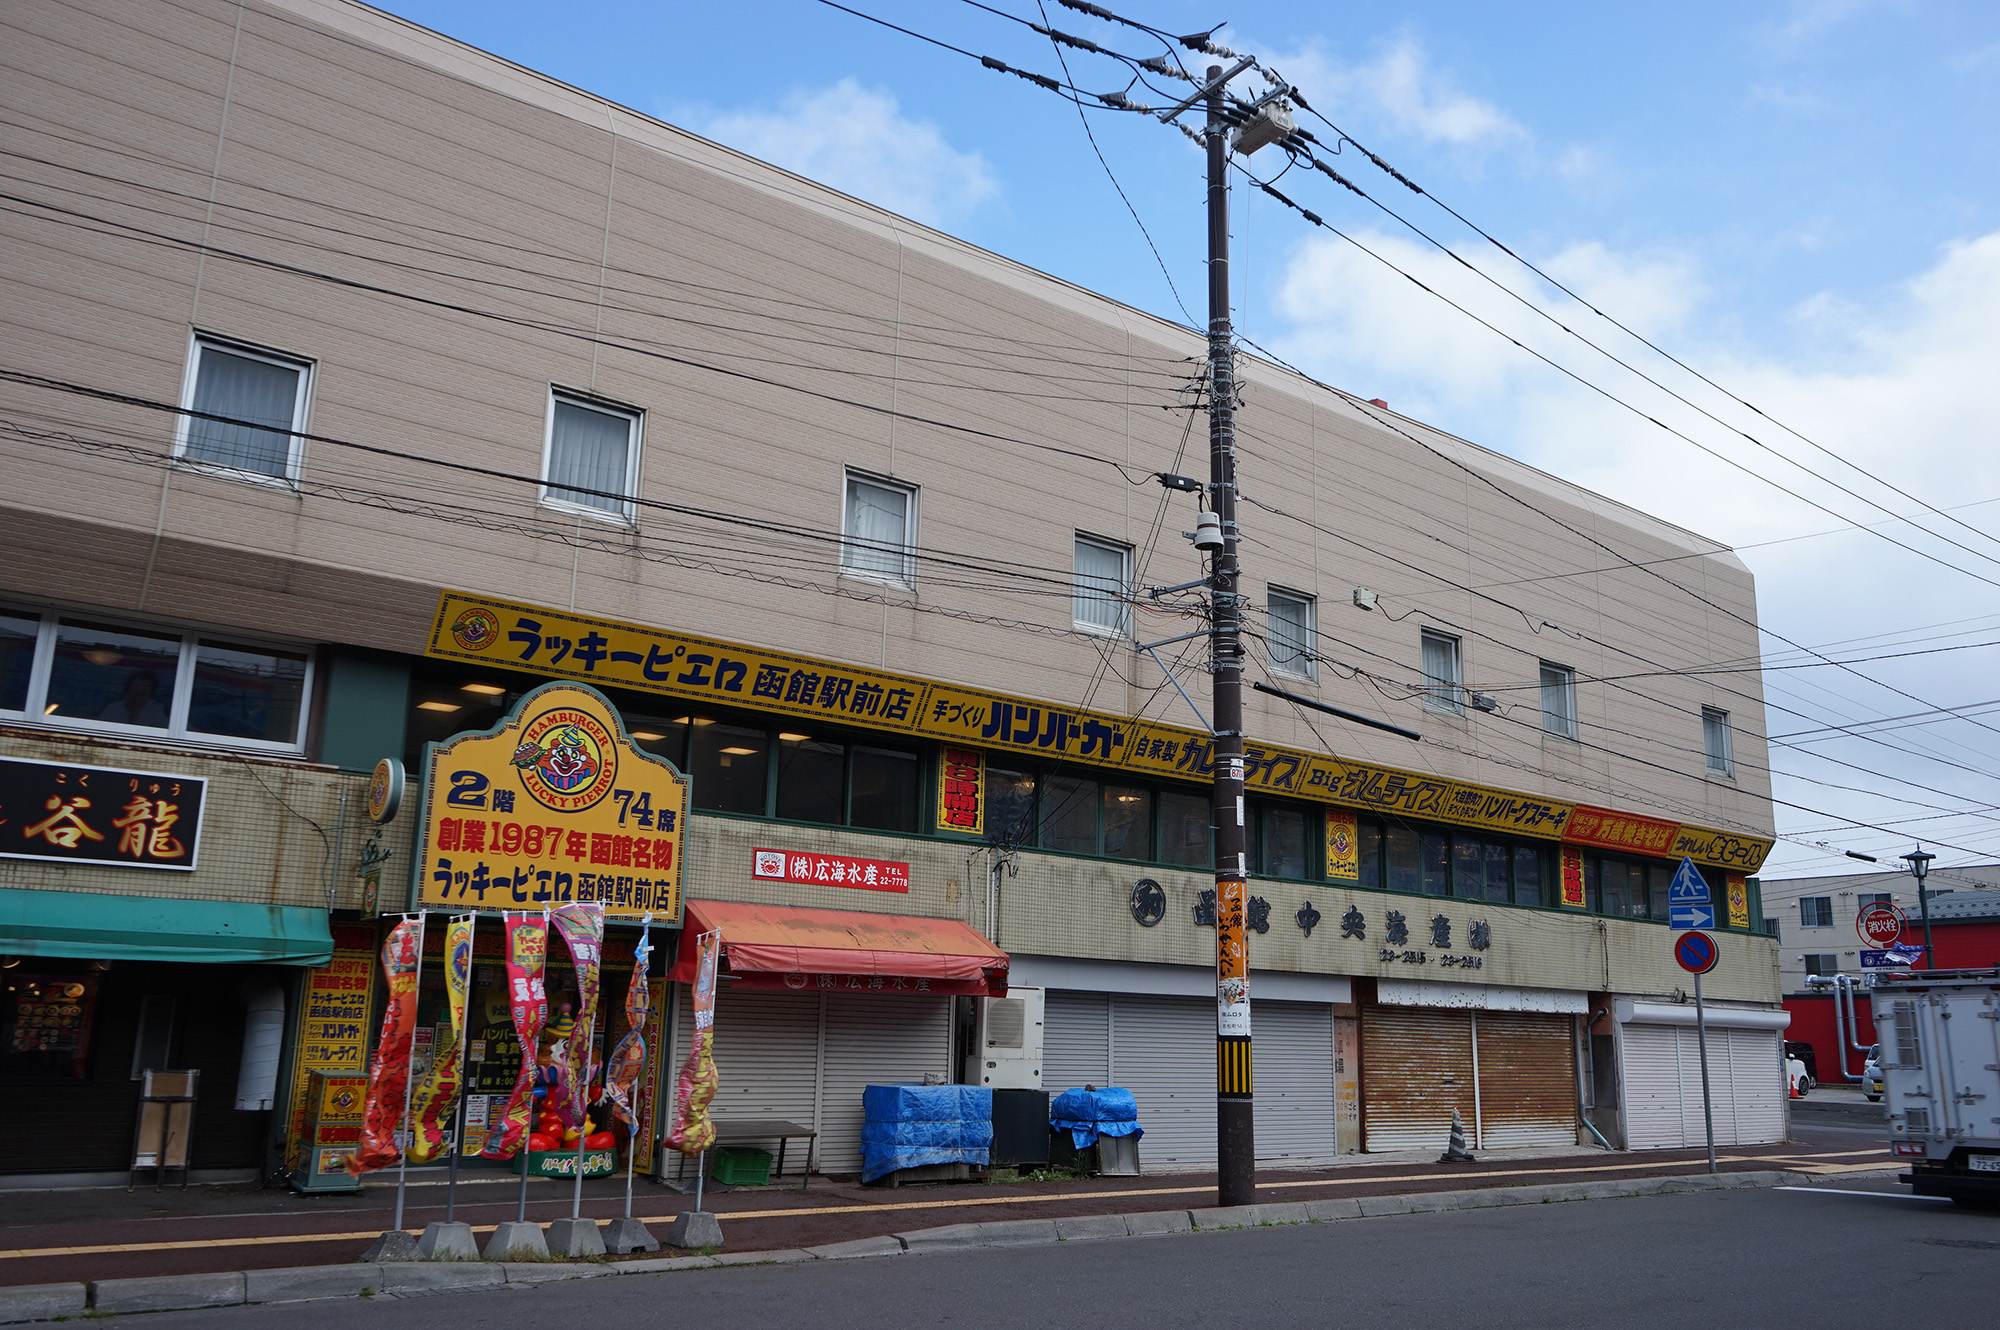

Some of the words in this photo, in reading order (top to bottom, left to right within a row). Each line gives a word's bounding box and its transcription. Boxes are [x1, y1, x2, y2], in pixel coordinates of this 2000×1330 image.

[508, 618, 747, 692] ラッキーピエロ
[751, 663, 915, 721] 函館駅前店
[528, 713, 609, 747] HAMBURGER
[932, 700, 985, 728] 手づくり
[981, 701, 1124, 758] ハンバーガー
[1134, 736, 1180, 763] 自家製
[1175, 738, 1301, 788] カレライス
[55, 772, 89, 787] こく
[129, 778, 181, 796] りゅう
[447, 770, 516, 813] 2階
[526, 773, 569, 808] LUCKY
[573, 759, 614, 808] PIERROT
[944, 749, 979, 827] 朝8時開店
[1307, 768, 1344, 793] Big
[1340, 769, 1448, 813] オムライス
[0, 795, 185, 858] 谷龍
[614, 789, 677, 832] 74席
[1478, 795, 1567, 830] ハンバーグステーキ
[1675, 835, 1709, 853] うれしい
[1706, 835, 1762, 866] 生ビール
[433, 858, 573, 903] ラッキーピエロ
[577, 872, 670, 910] 函館駅前店
[789, 856, 879, 886] (株)広海水産
[879, 876, 908, 887] 22-7778
[885, 867, 902, 876] TEL
[1867, 918, 1898, 934] 消火栓
[311, 991, 365, 1004] ラッキーピエロ
[312, 975, 368, 991] 函館名物
[309, 1005, 364, 1019] 函館駅前店
